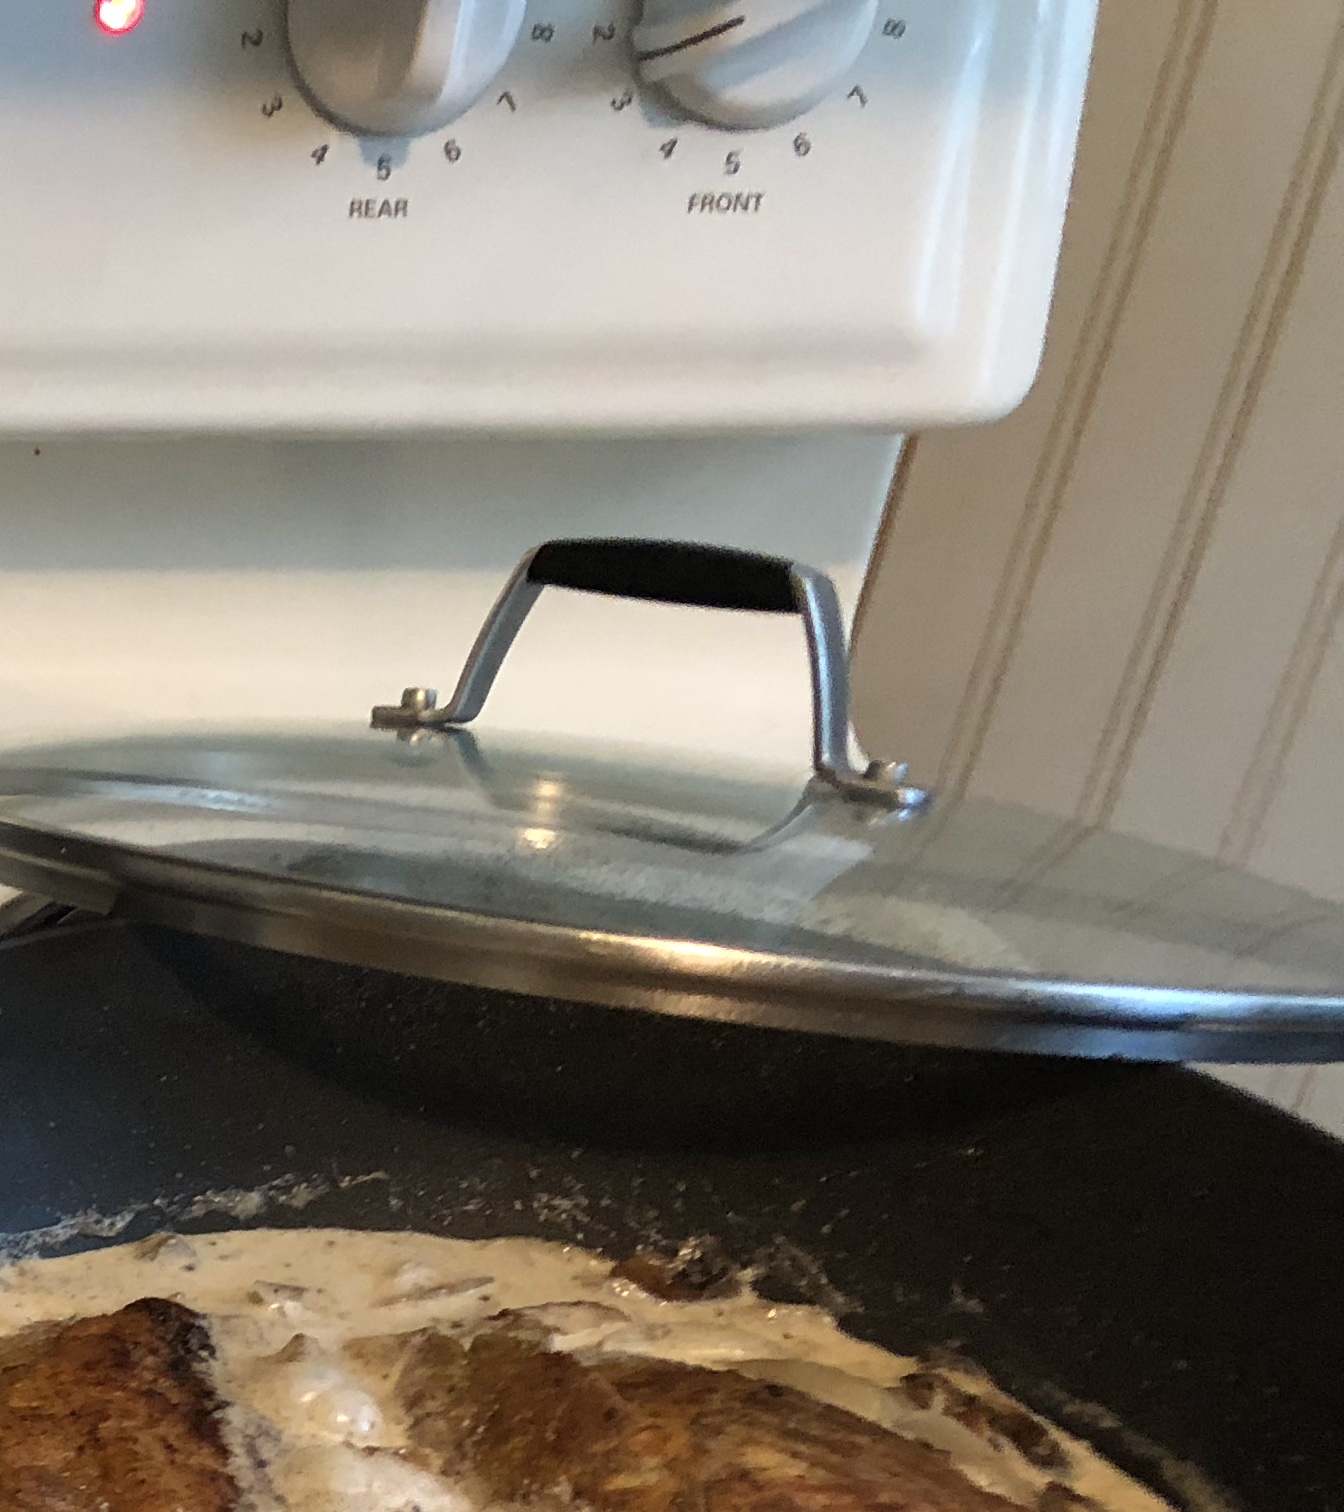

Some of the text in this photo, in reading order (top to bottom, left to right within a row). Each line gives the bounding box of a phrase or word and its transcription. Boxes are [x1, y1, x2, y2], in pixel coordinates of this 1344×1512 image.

[241, 29, 263, 48] 2
[530, 22, 555, 43] 8
[593, 21, 615, 44] 2
[882, 17, 906, 39] 8
[496, 91, 517, 112] 7
[847, 84, 868, 107] 7
[311, 144, 329, 165] 4
[444, 138, 461, 164] 6
[659, 137, 678, 160] 4
[793, 131, 811, 157] 6
[376, 153, 391, 182] 5
[724, 150, 741, 175] 5
[348, 198, 409, 219] REAR
[687, 190, 767, 214] FRONT
